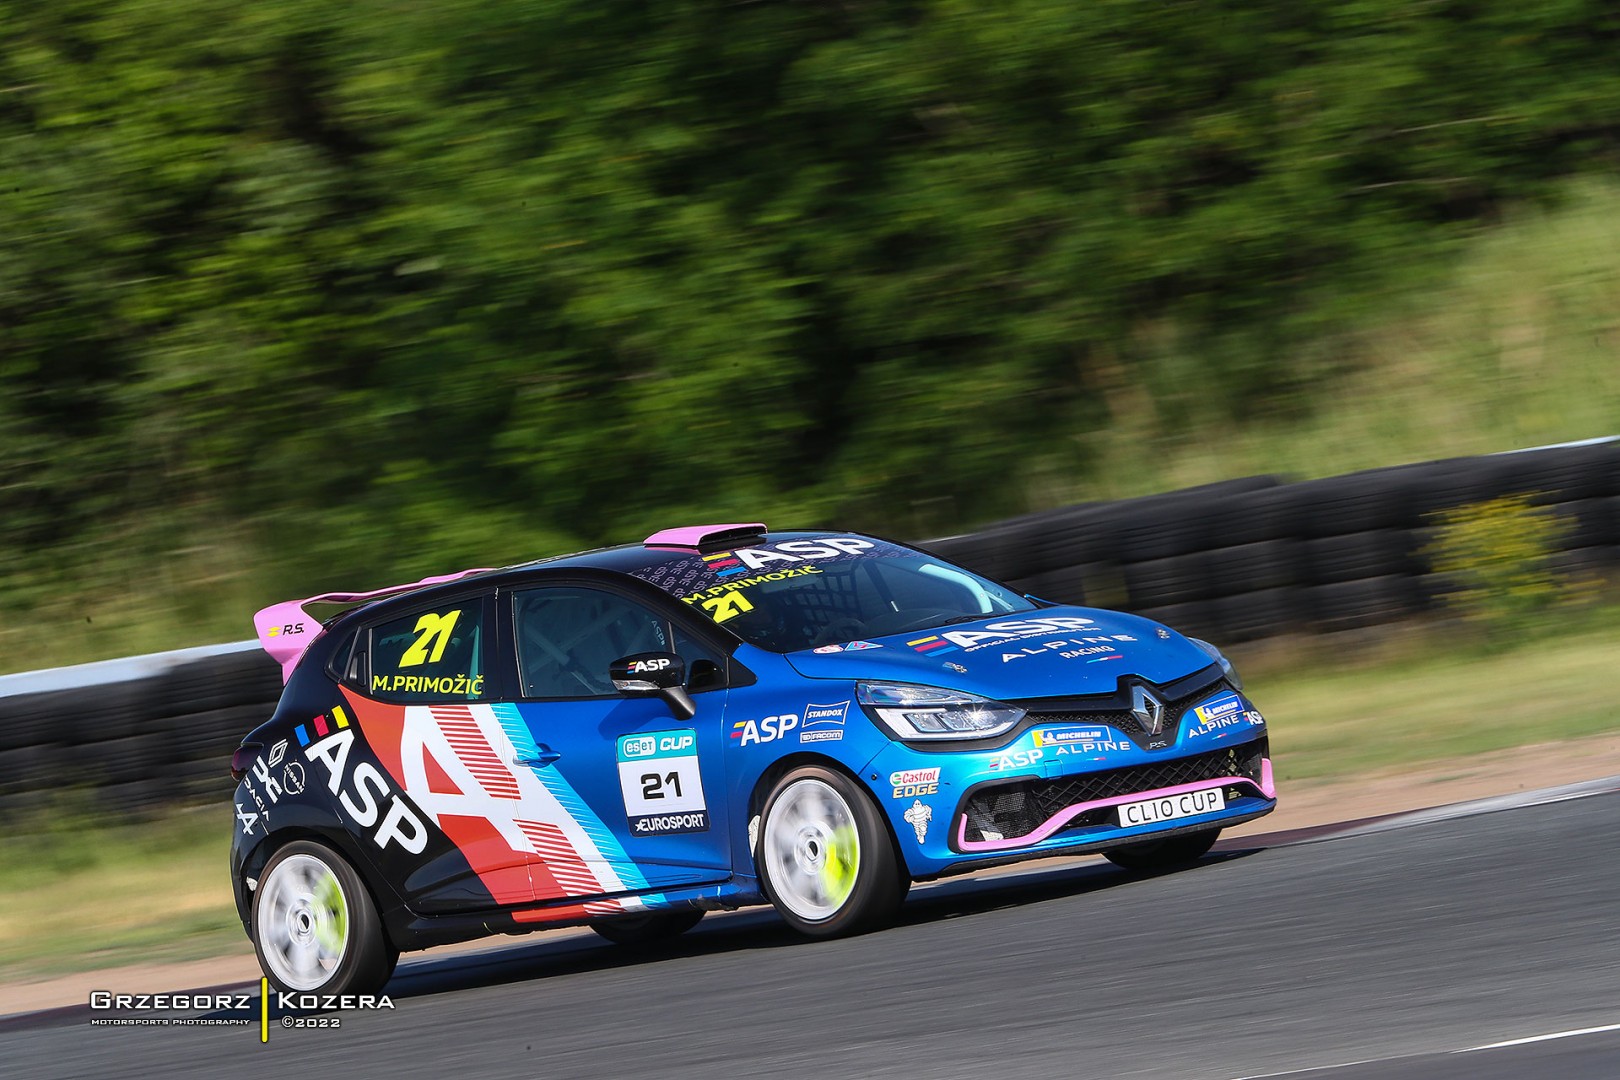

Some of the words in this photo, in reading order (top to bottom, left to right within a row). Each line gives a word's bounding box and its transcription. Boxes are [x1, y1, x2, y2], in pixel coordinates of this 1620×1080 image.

[734, 538, 875, 569] ASP
[701, 590, 755, 624] 21
[399, 609, 462, 668] 21
[941, 617, 1095, 648] ASP
[1002, 634, 1138, 663] ALPINE
[1059, 645, 1116, 660] RACING
[634, 658, 670, 673] ASP
[372, 673, 484, 695] M.PRIMOŽIČ
[807, 708, 844, 719] STANDOX
[741, 713, 798, 747] ASP
[1056, 731, 1102, 741] MICHELIN
[1188, 714, 1239, 739] ALPINE
[659, 735, 694, 751] CUP
[1055, 741, 1131, 756] ALPINE
[999, 749, 1044, 771] ASP
[284, 763, 305, 793] NISSAN
[640, 771, 682, 800] 21
[902, 770, 936, 784] Castrol
[244, 774, 270, 822] DACIA
[304, 728, 428, 855] ASP
[892, 783, 939, 799] EDGE
[1126, 799, 1174, 824] CLIO
[1180, 791, 1217, 815] CUP
[636, 813, 704, 832] EUROSPORT
